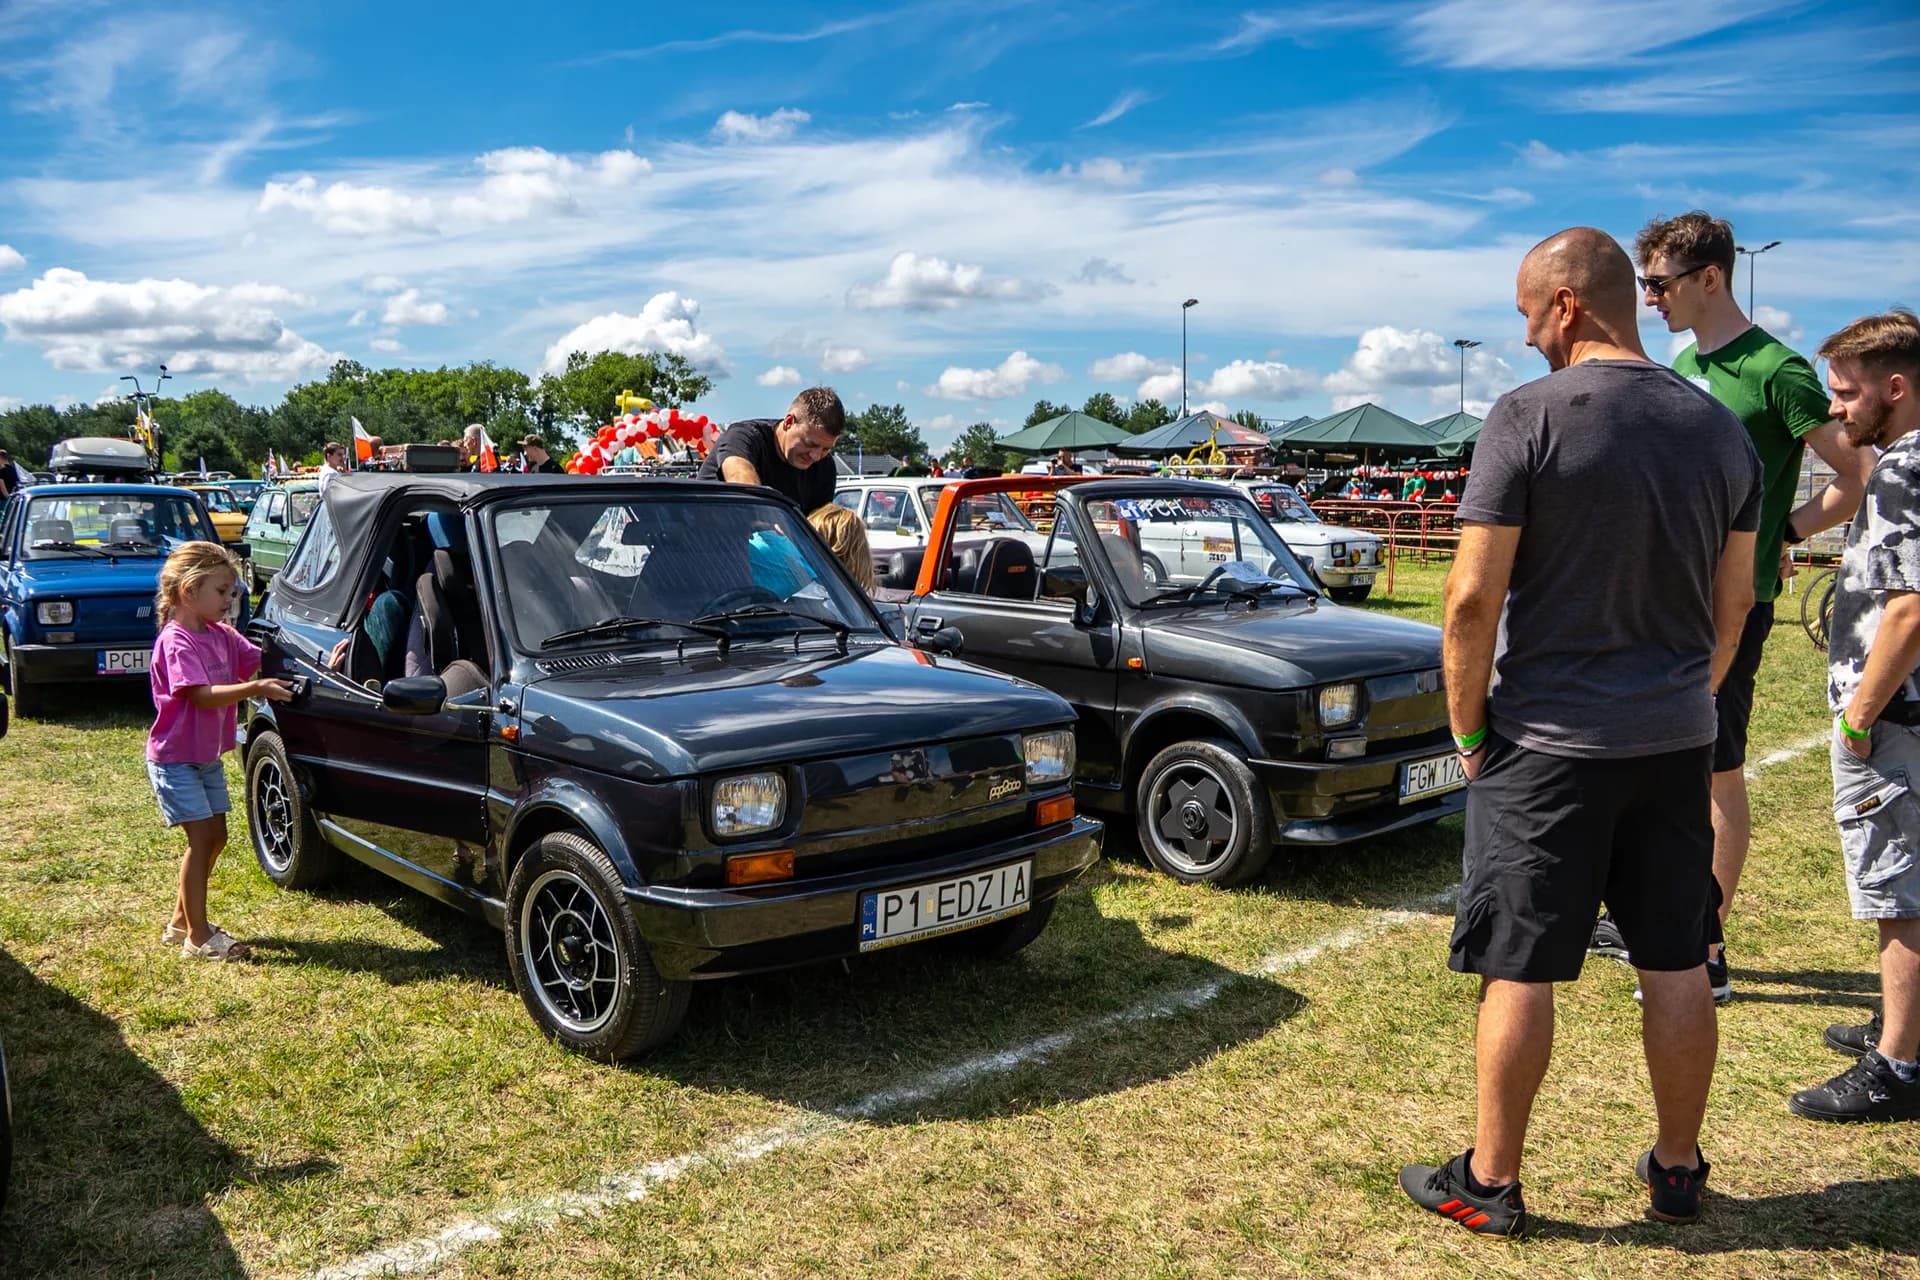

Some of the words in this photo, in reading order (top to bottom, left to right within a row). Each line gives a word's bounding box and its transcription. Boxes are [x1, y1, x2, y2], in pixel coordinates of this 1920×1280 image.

[109, 652, 144, 669] PCH
[1408, 760, 1438, 794] FGW
[883, 890, 920, 934] P1
[937, 865, 1026, 922] EDZIA
[863, 922, 875, 934] PL
